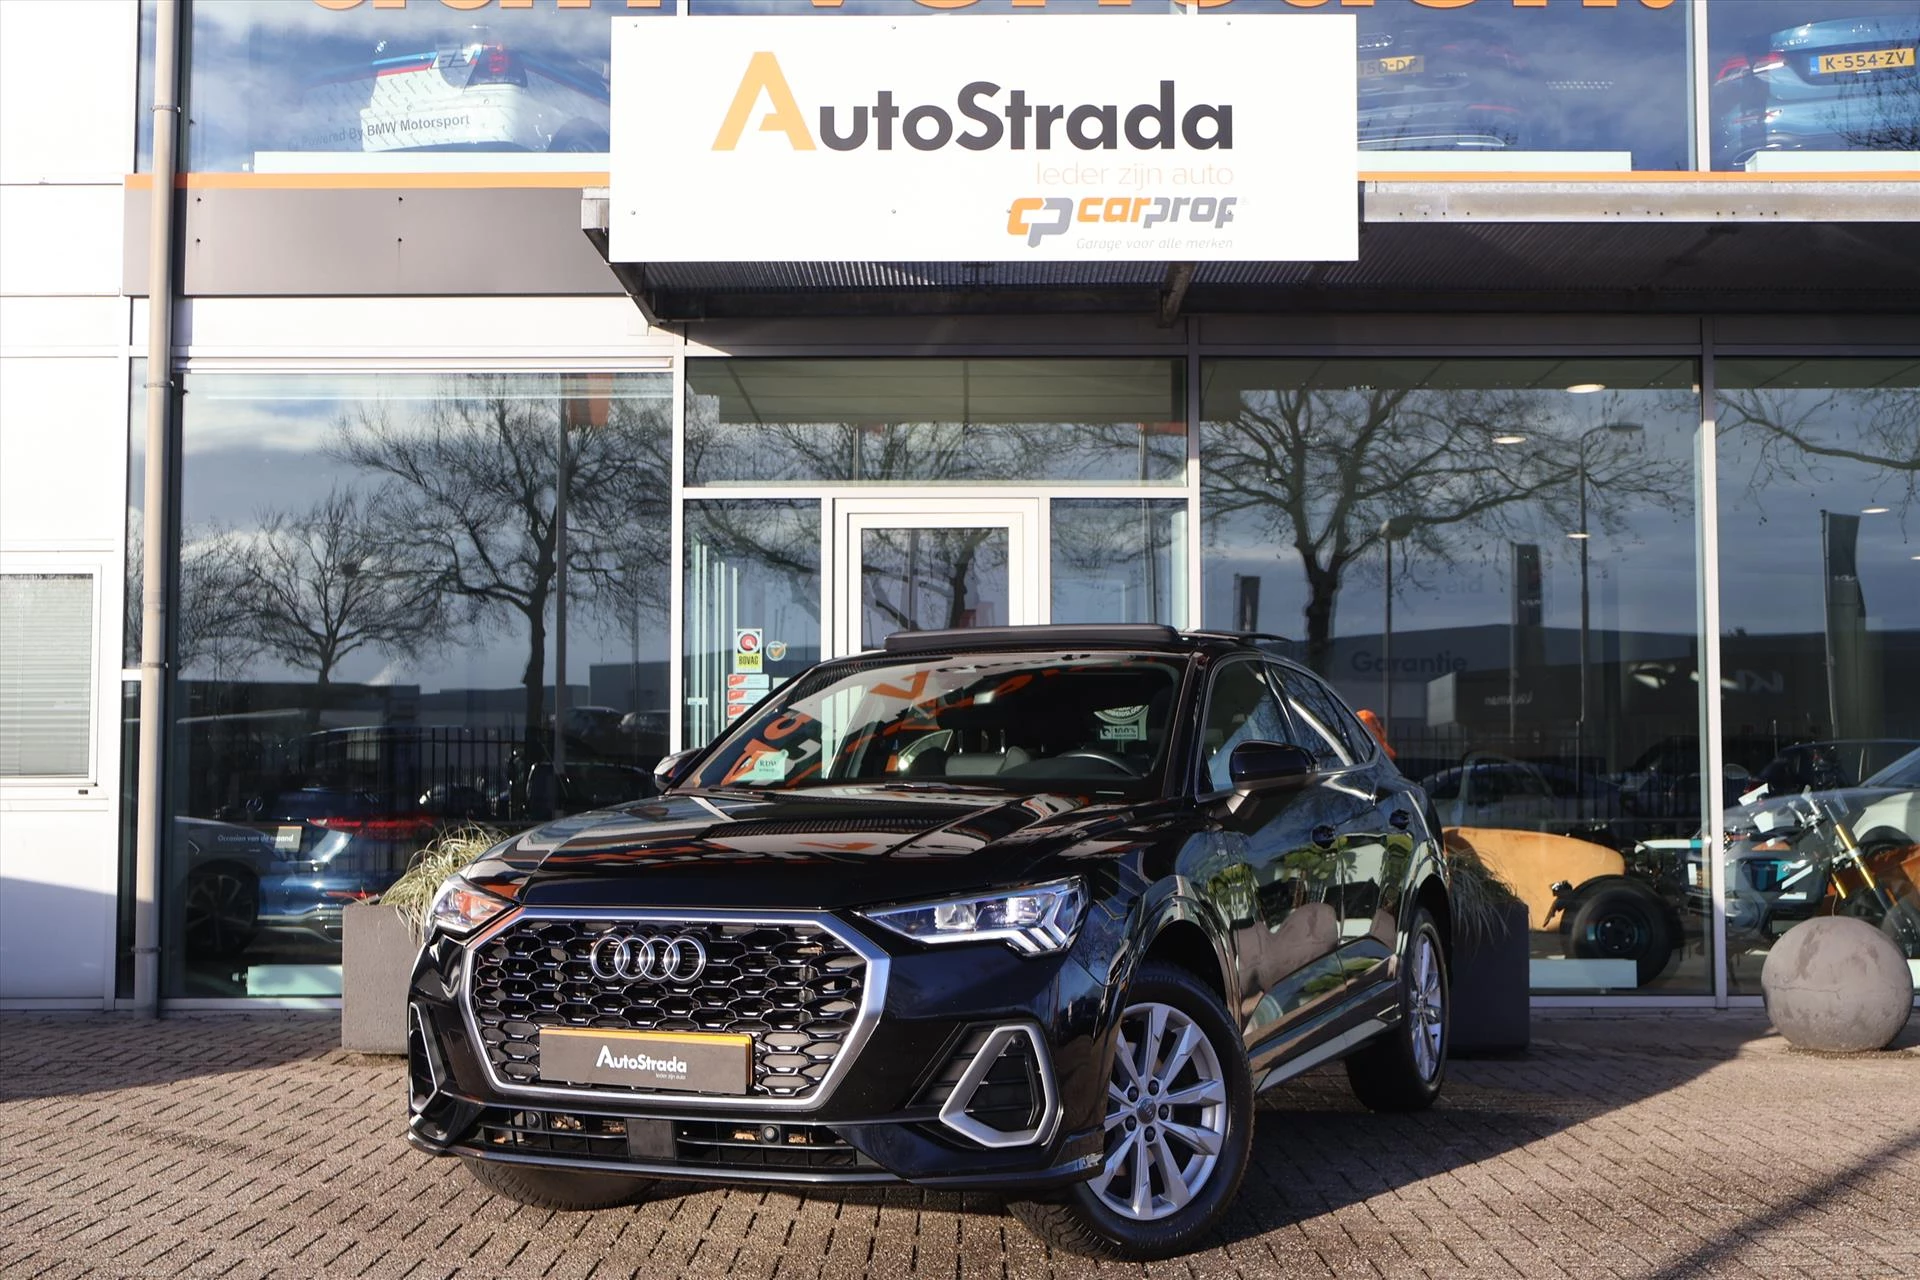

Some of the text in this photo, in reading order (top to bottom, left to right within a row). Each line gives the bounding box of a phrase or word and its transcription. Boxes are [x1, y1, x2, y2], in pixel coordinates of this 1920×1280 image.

[1825, 51, 1906, 70] K-554-ZV
[711, 51, 1233, 151] AutoStrada
[349, 127, 363, 142] By
[367, 120, 397, 136] BMW
[400, 114, 471, 132] Motorsport
[1118, 163, 1162, 191] zijn
[1172, 164, 1234, 186] auto
[1076, 238, 1233, 251] Garage voor alle merken
[738, 655, 759, 665] BOVAG
[1351, 650, 1468, 673] Garantie
[596, 1044, 687, 1073] AutoStrada
